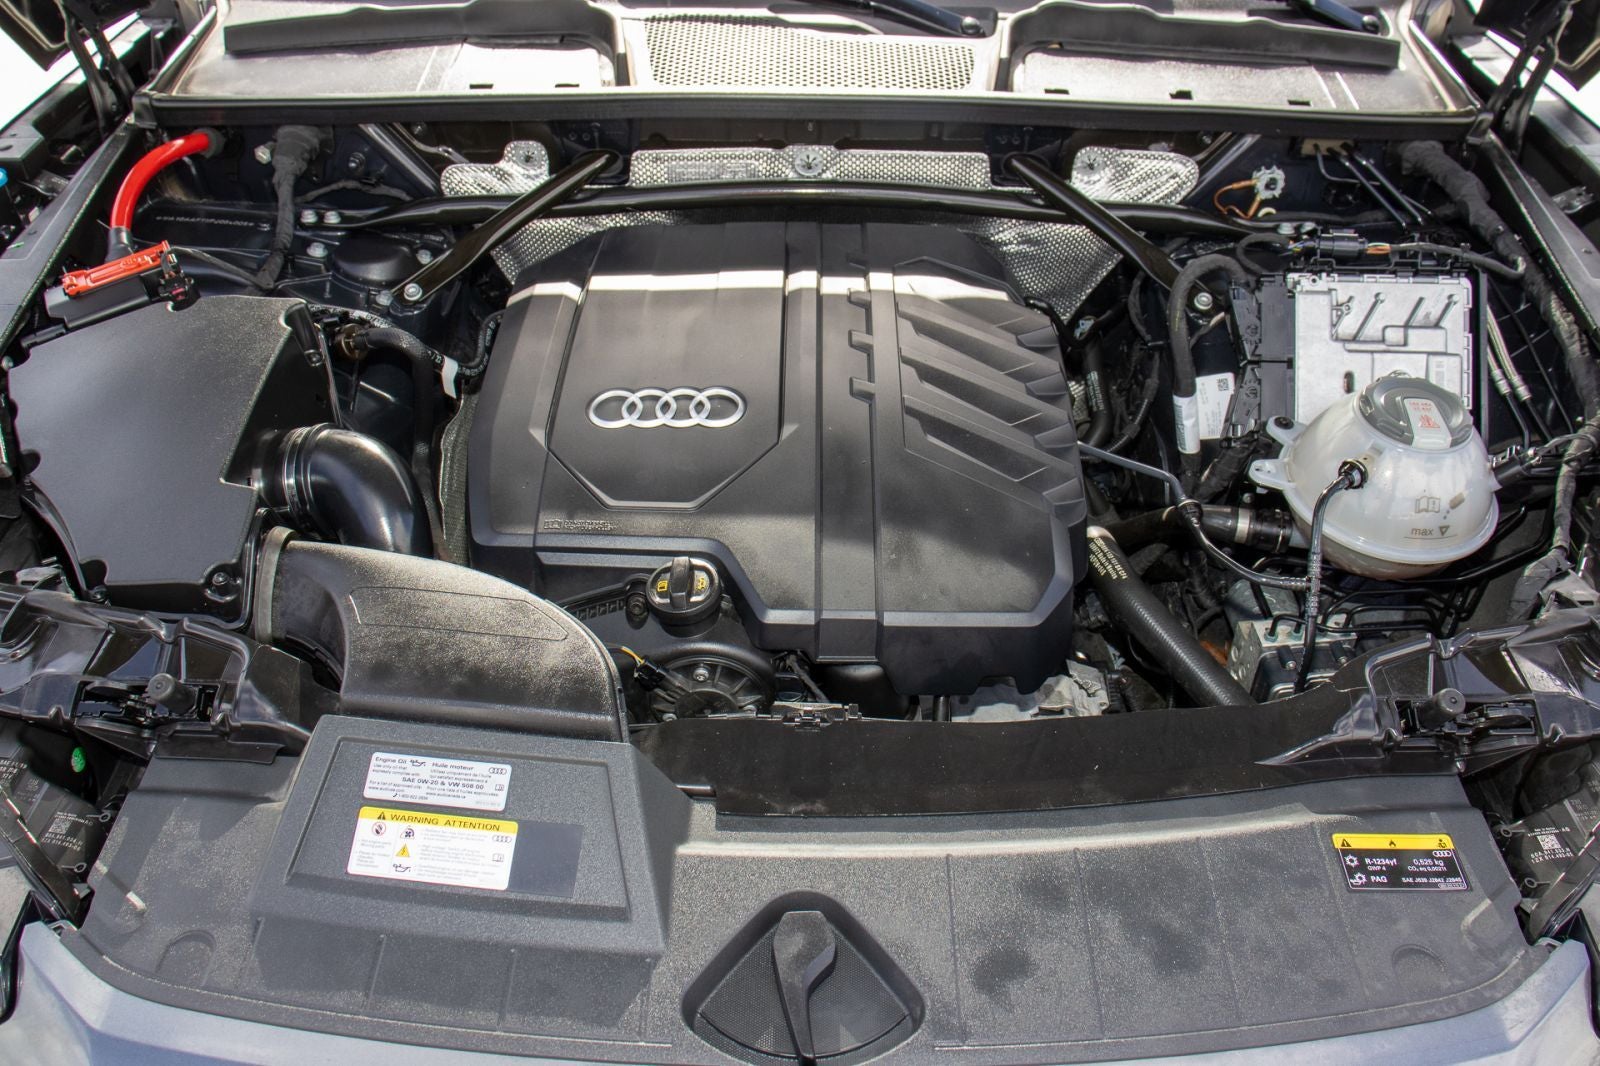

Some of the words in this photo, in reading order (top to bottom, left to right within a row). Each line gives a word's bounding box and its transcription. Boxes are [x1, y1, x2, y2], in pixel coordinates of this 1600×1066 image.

[1411, 528, 1434, 536] max
[390, 814, 439, 826] WARNING
[444, 819, 500, 832] ATTENTION
[1364, 858, 1397, 866] R-1234yf
[1434, 858, 1444, 866] kg
